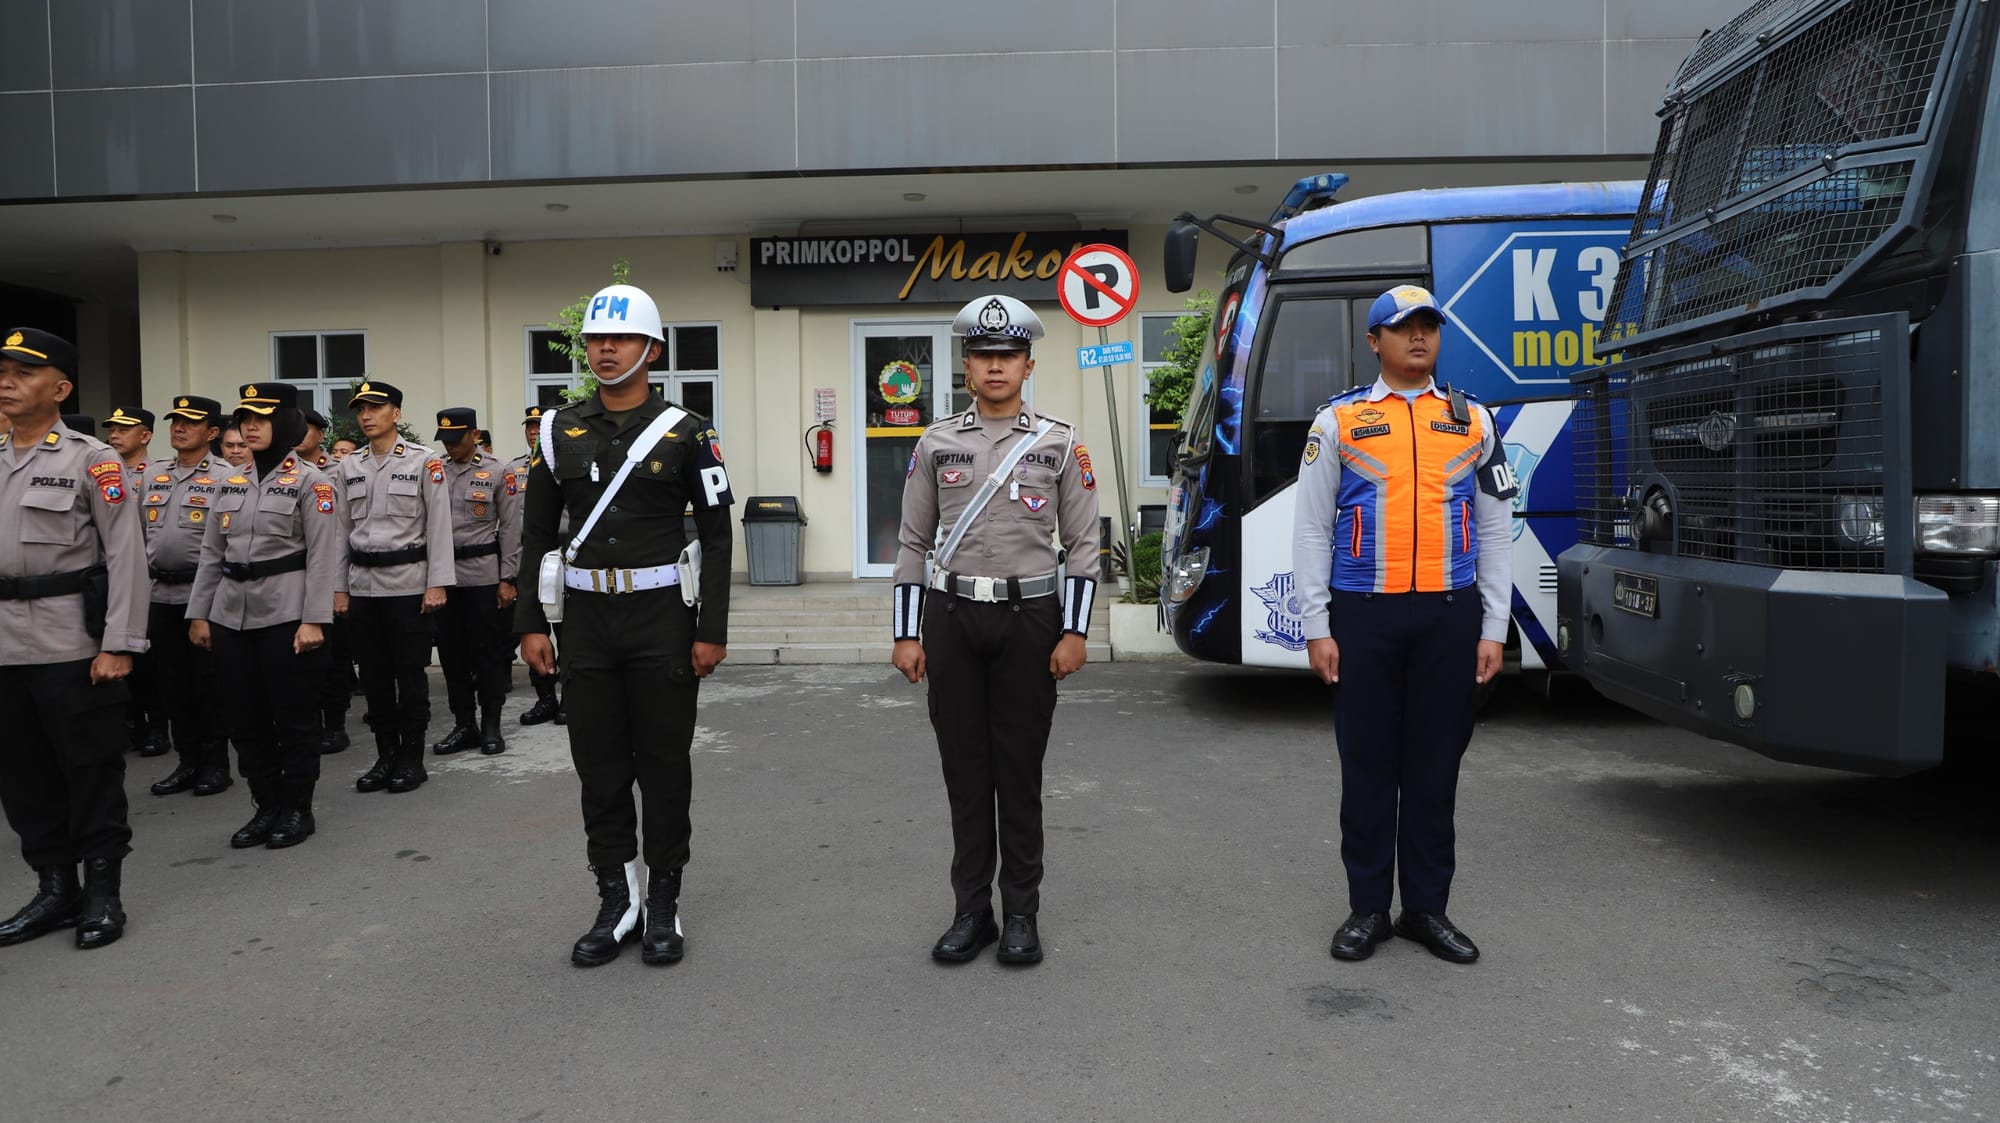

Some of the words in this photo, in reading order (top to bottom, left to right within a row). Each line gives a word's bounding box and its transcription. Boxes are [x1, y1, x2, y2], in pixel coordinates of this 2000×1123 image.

[760, 238, 915, 265] PRIMKOPPOL
[898, 231, 1081, 300] Mako
[1512, 248, 1560, 321] K
[591, 296, 630, 320] PM
[1080, 349, 1098, 366] R2
[1433, 423, 1467, 433] DISHUB
[935, 453, 974, 465] SEPTIAN
[1020, 453, 1056, 467] OLRI
[30, 477, 76, 488] POLRI
[391, 473, 419, 482] POLRI
[188, 485, 216, 494] POLRI
[470, 480, 493, 488] POLRI
[700, 466, 729, 507] P
[221, 486, 248, 495] RIYAN
[266, 487, 299, 497] POLRI
